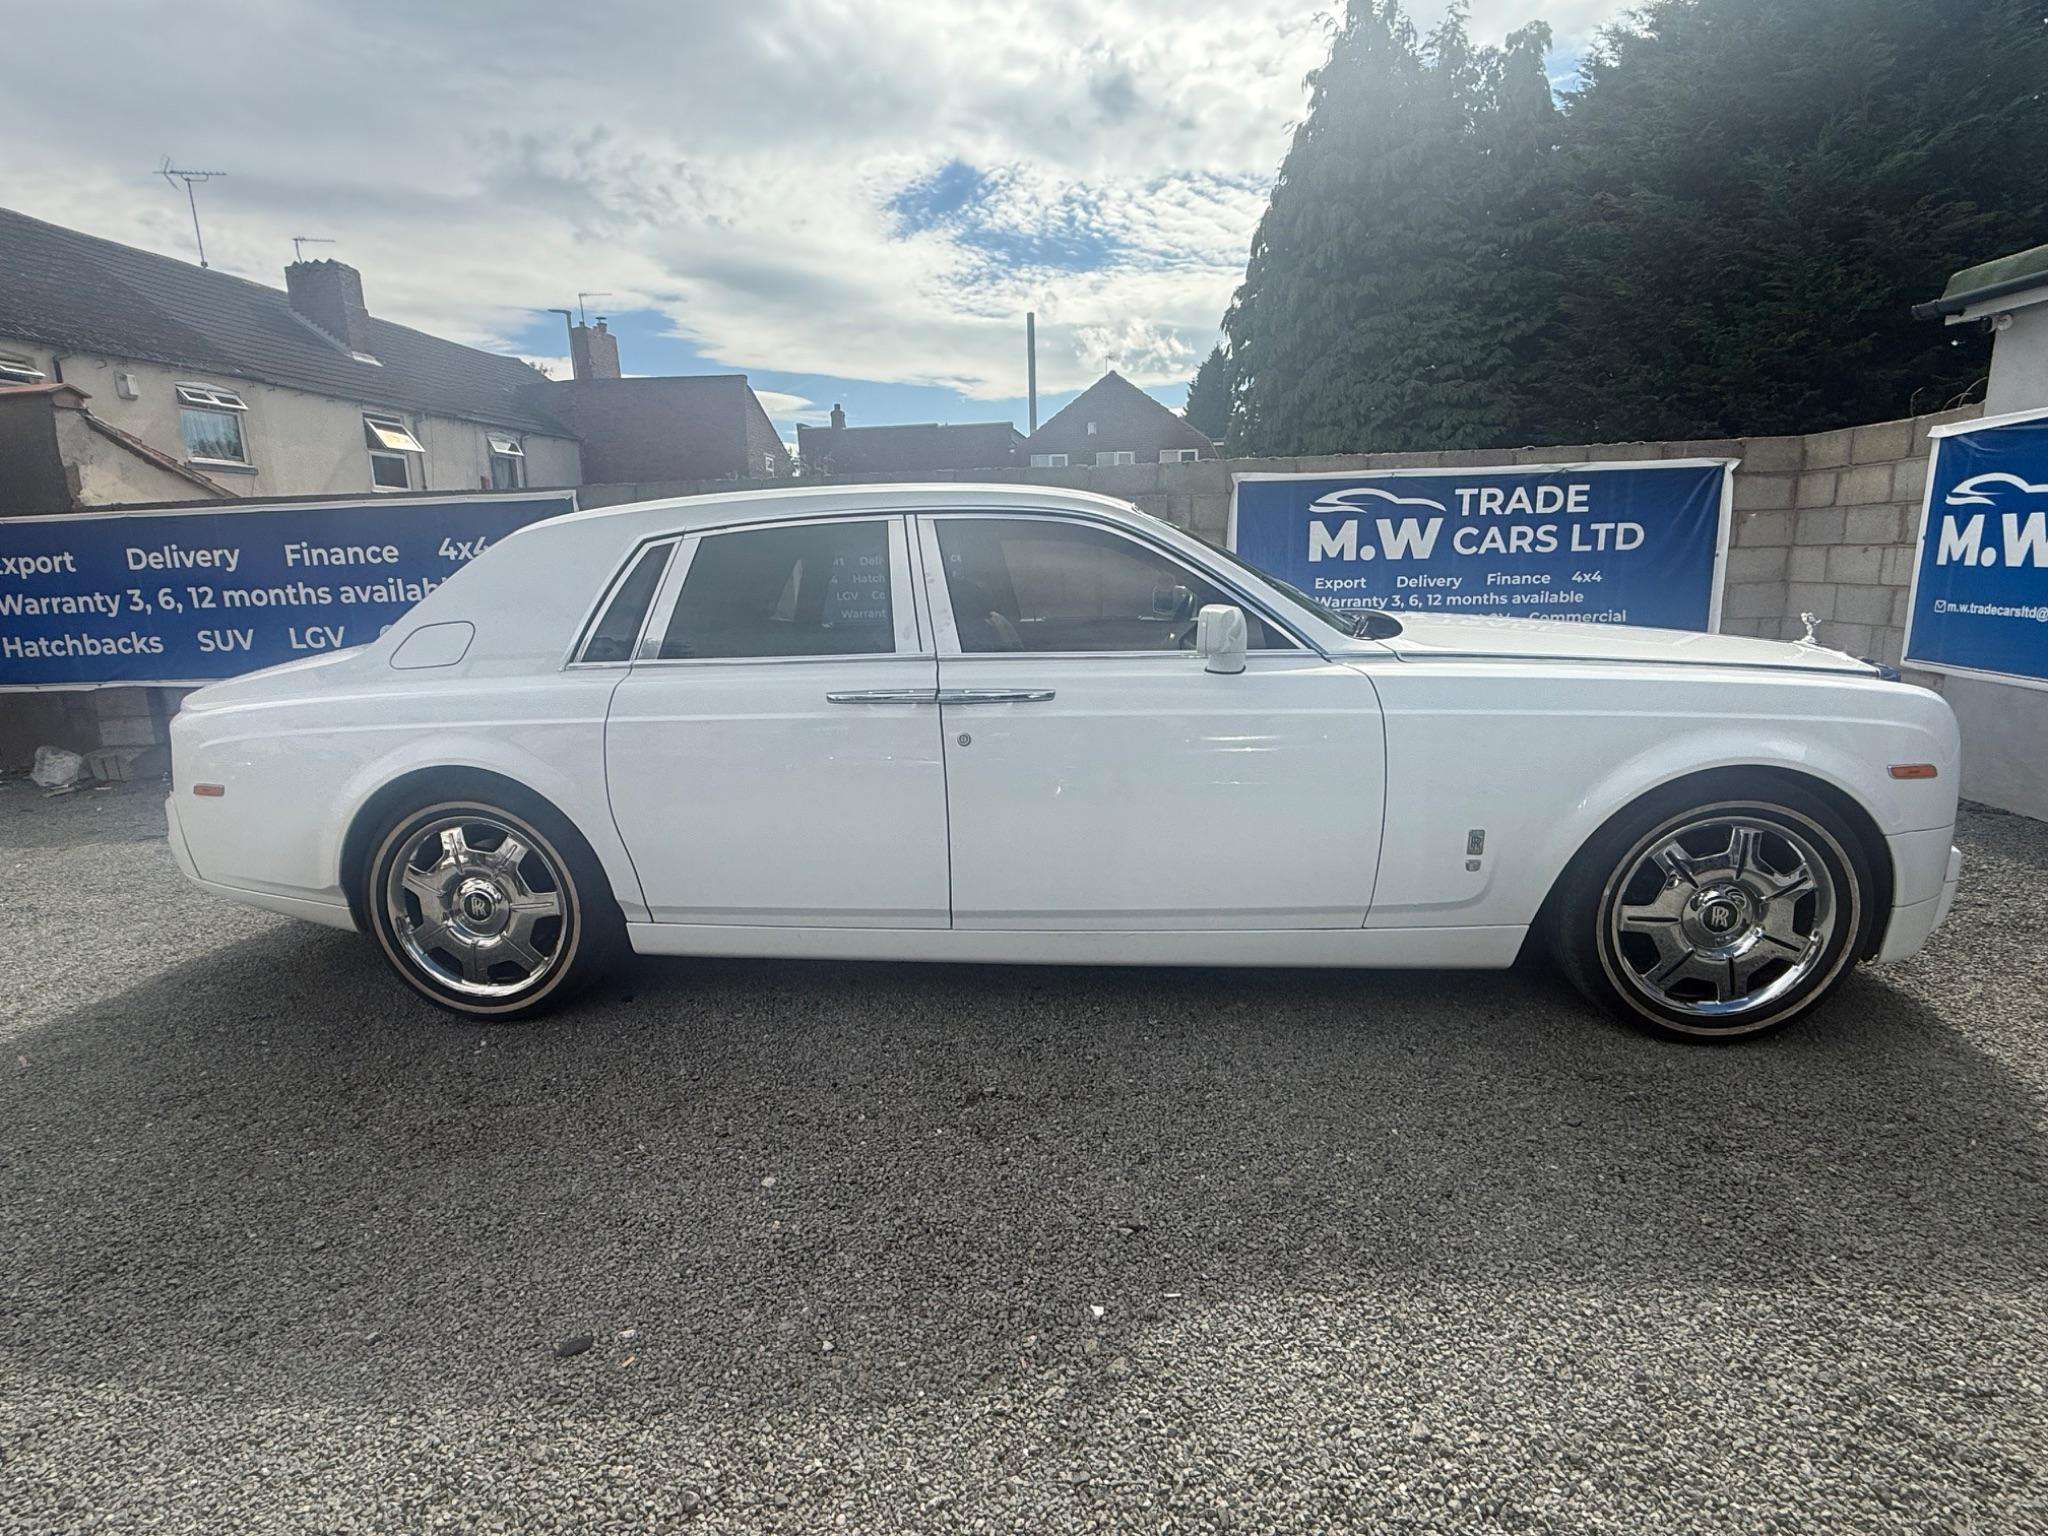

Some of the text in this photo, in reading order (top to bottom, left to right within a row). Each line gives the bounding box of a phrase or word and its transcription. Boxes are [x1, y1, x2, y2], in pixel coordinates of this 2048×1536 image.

[1455, 484, 1591, 517] TRADE
[1308, 517, 1444, 562] M.W
[1453, 522, 1645, 555] CARS LTD
[0, 551, 77, 579] xport
[126, 544, 240, 572] Delivery
[284, 541, 400, 567] Finance
[0, 576, 448, 618] Warranty 3, 6, 12 months availab
[1315, 570, 1603, 592] Export Delivery Finance 4x4
[1391, 595, 1405, 608] 3,
[1408, 594, 1423, 608] 6,
[1427, 594, 1442, 606] 12
[1446, 592, 1508, 606] months
[1512, 590, 1584, 605] available
[2, 625, 345, 658] Hatchbacks SUV LGV
